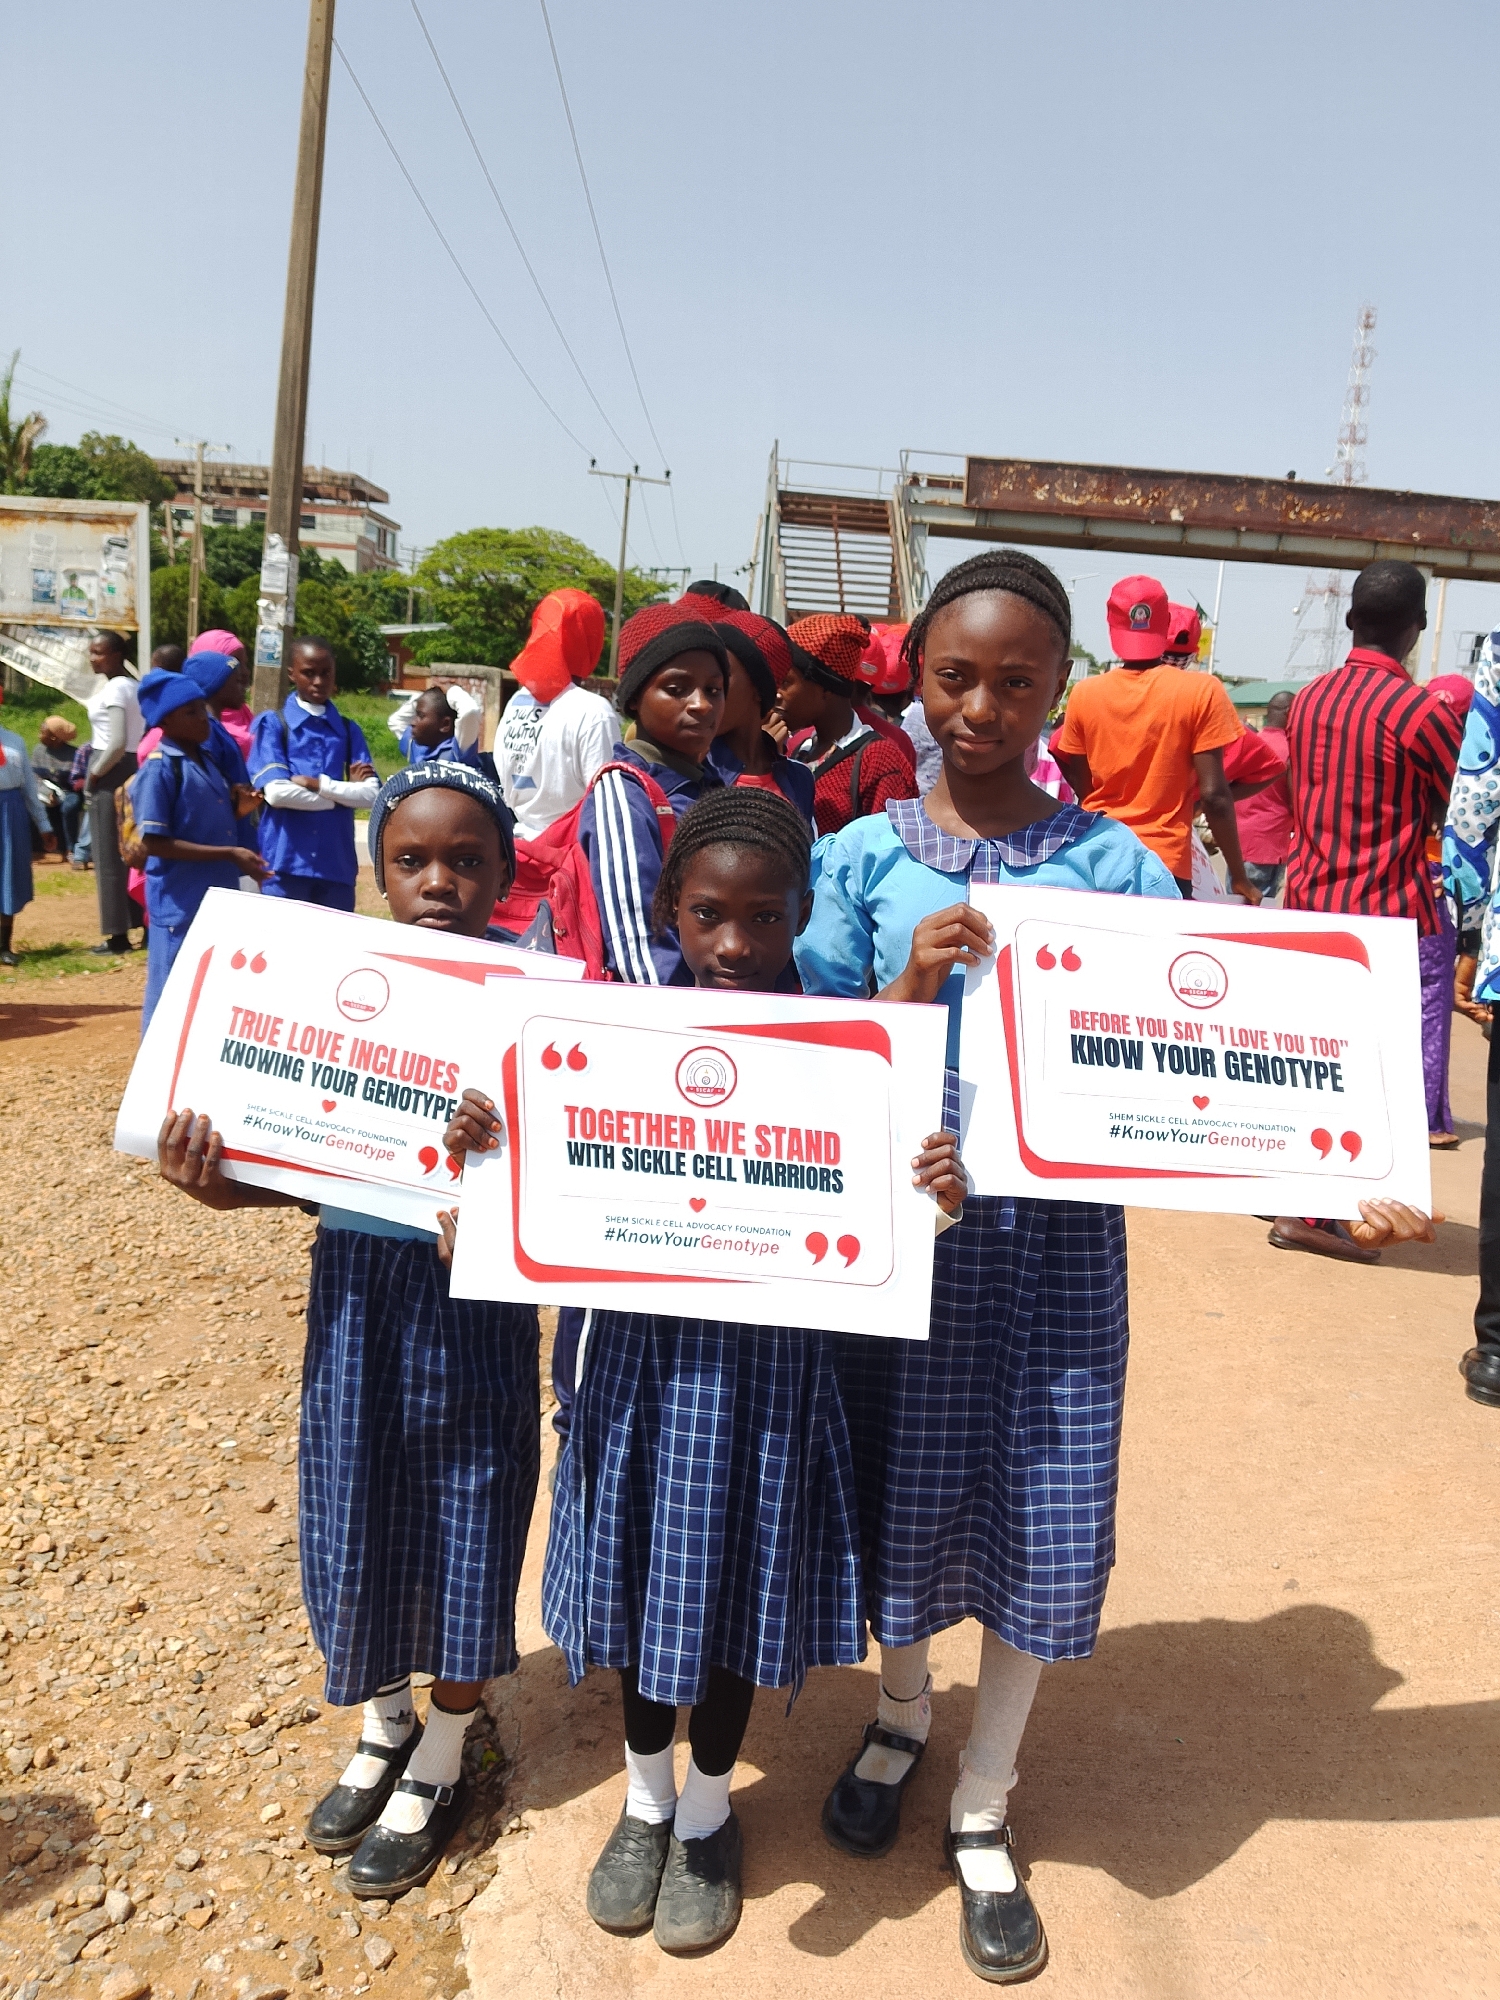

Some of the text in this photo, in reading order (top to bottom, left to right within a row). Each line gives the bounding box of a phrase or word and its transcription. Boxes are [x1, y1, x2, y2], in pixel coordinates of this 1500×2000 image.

[229, 1006, 460, 1094] TRUE LOVE INCLUDES
[1069, 1009, 1348, 1059] BEFORE YOU SAY "I LOVE YOU TOO"
[220, 1038, 457, 1124] KNOWING YOUR GENOTYPE
[1070, 1034, 1344, 1093] KNOW YOUR GENOTYPE
[243, 1115, 395, 1161] #KnowYourGenotype
[246, 1103, 407, 1147] SHEM SICKLE CELL ADVOCACY FOUNDATION
[564, 1105, 841, 1166] TOGETHER WE STAND
[1109, 1112, 1296, 1133] SHEM SICKLE CELL ADVOCACY FOUNDATION
[1109, 1124, 1286, 1151] #KnowYourGenotype
[566, 1140, 844, 1194] WITH SICKLE CELL WARRIORS
[604, 1227, 779, 1256] #KnowYourGenotype
[606, 1215, 791, 1237] SHEM SICKLE CELL ADVOCACY FOUNDATION
